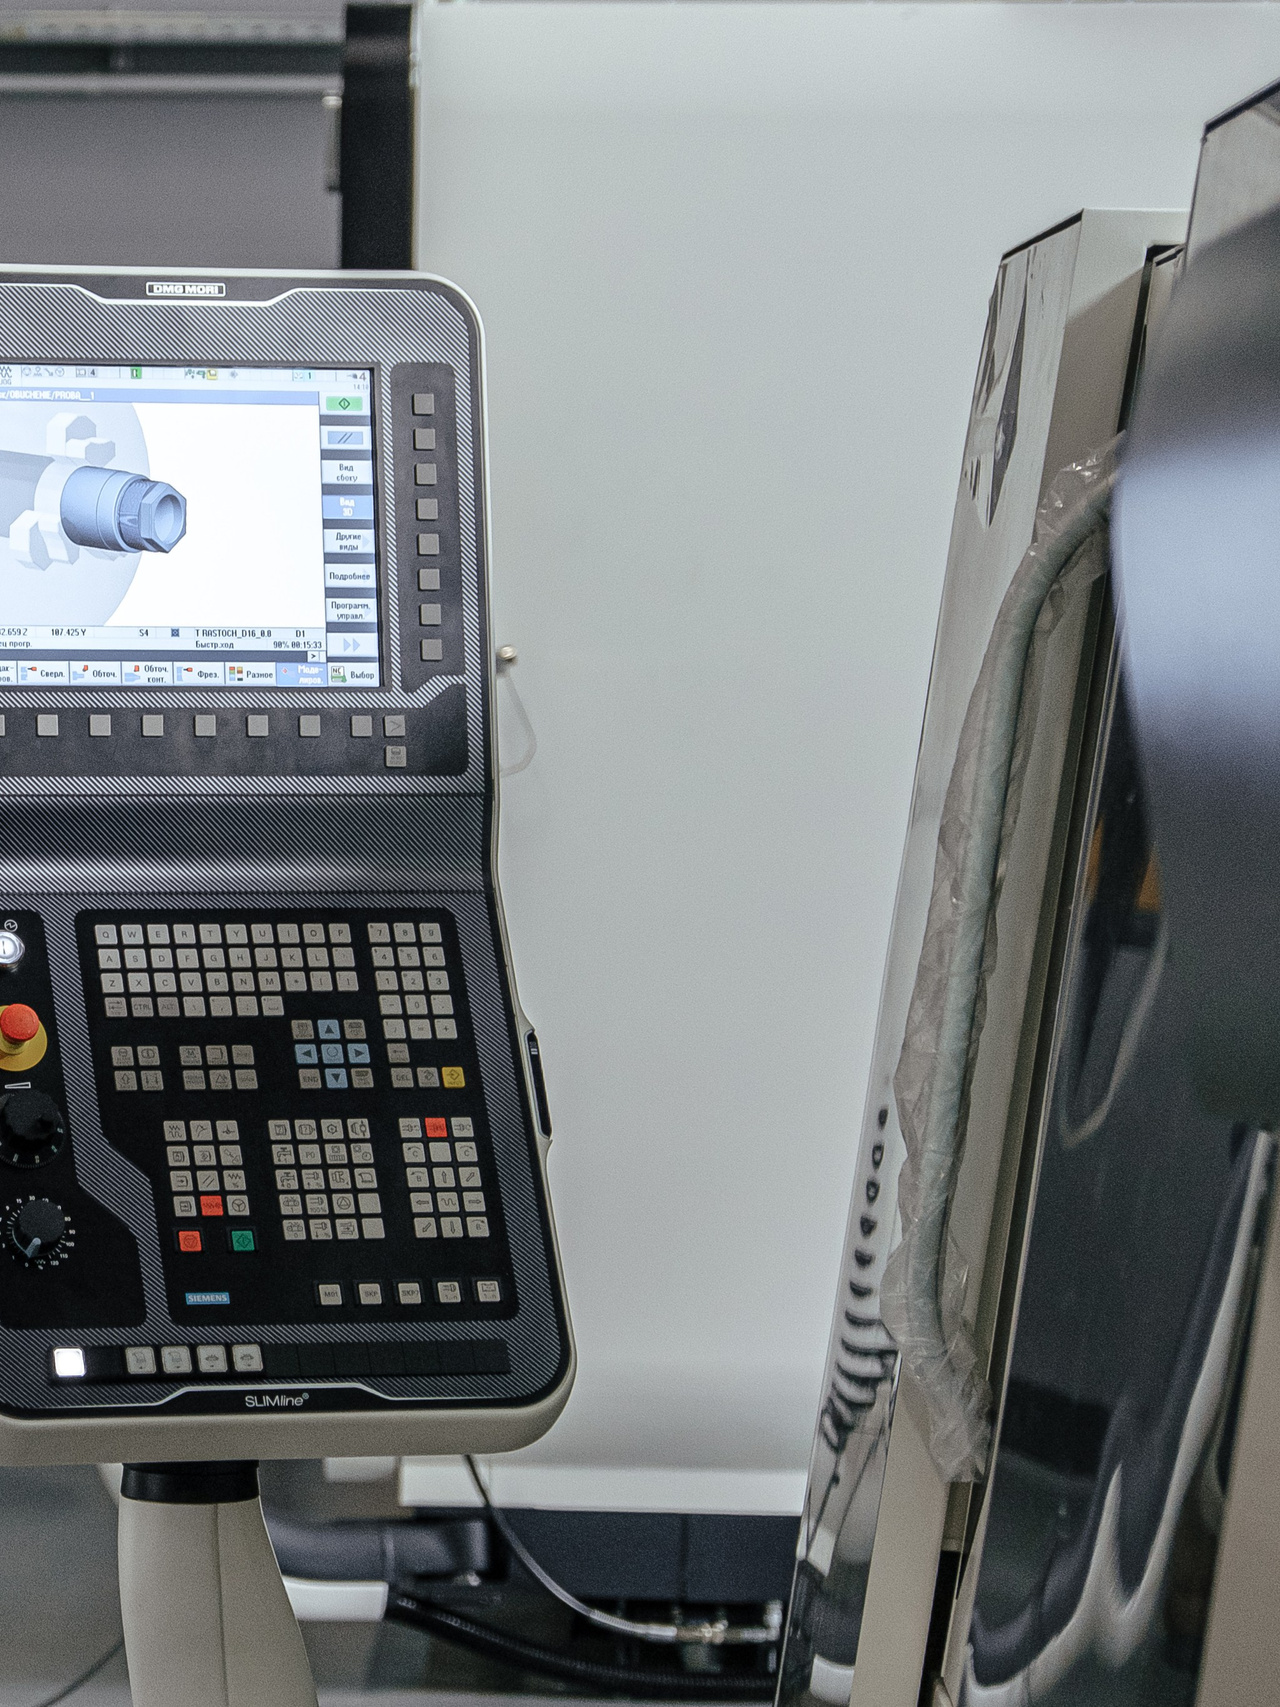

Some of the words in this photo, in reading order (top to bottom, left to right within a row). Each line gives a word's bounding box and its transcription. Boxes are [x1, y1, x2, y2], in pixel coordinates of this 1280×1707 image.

[153, 284, 184, 294] DMG
[184, 285, 219, 294] MORI
[359, 372, 366, 381] 4
[339, 463, 354, 471] Вид
[339, 497, 355, 507] Вид
[342, 508, 353, 516] 3D
[336, 532, 361, 541] Другие
[329, 572, 370, 581] Подробнее
[331, 601, 371, 610] Программ.
[337, 613, 365, 621] управл.
[23, 628, 28, 636] Z
[139, 629, 149, 637] S4
[195, 629, 200, 637] T
[9, 640, 32, 648] прогр.
[144, 664, 169, 672] Обточ.
[40, 670, 65, 678] Сверл.
[92, 669, 117, 678] Обточ.
[197, 670, 220, 679] Фрез.
[350, 671, 374, 679] Выбор
[132, 955, 139, 963] S
[162, 979, 169, 987] C
[188, 1294, 227, 1302] SIEMENS
